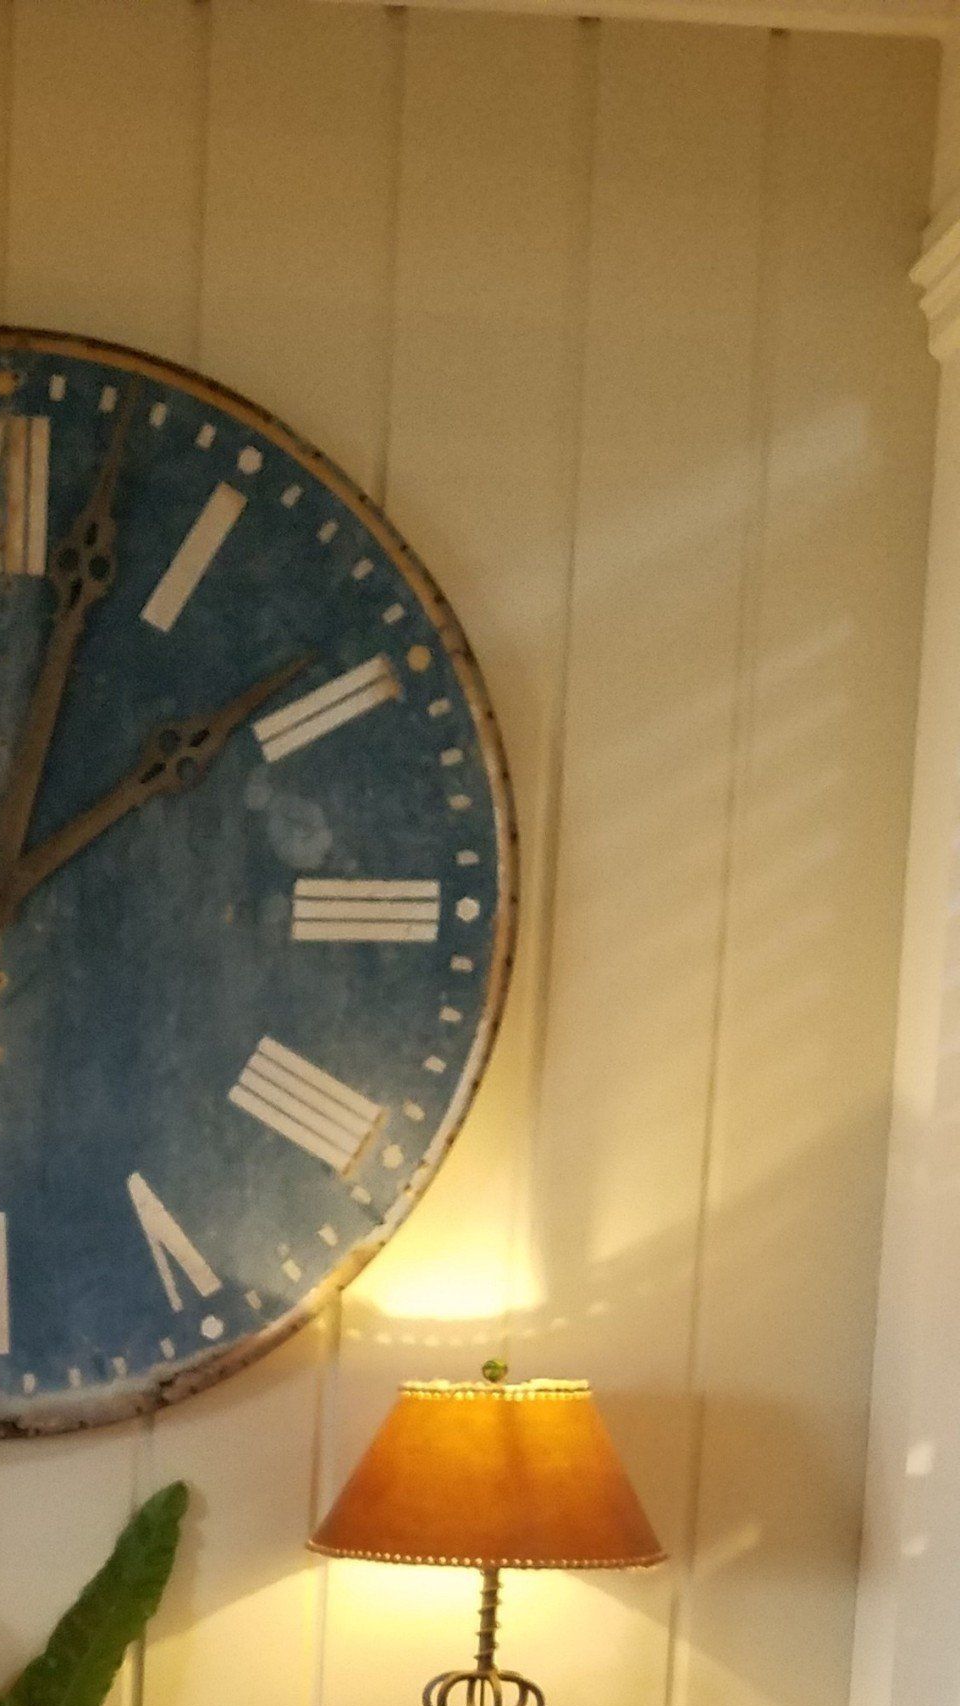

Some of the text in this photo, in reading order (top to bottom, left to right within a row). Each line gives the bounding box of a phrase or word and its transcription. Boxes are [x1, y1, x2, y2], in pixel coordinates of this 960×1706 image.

[140, 481, 247, 633] I
[252, 653, 400, 765] II
[292, 878, 441, 942] III
[228, 1034, 389, 1181] IIII
[126, 1171, 223, 1313] V
